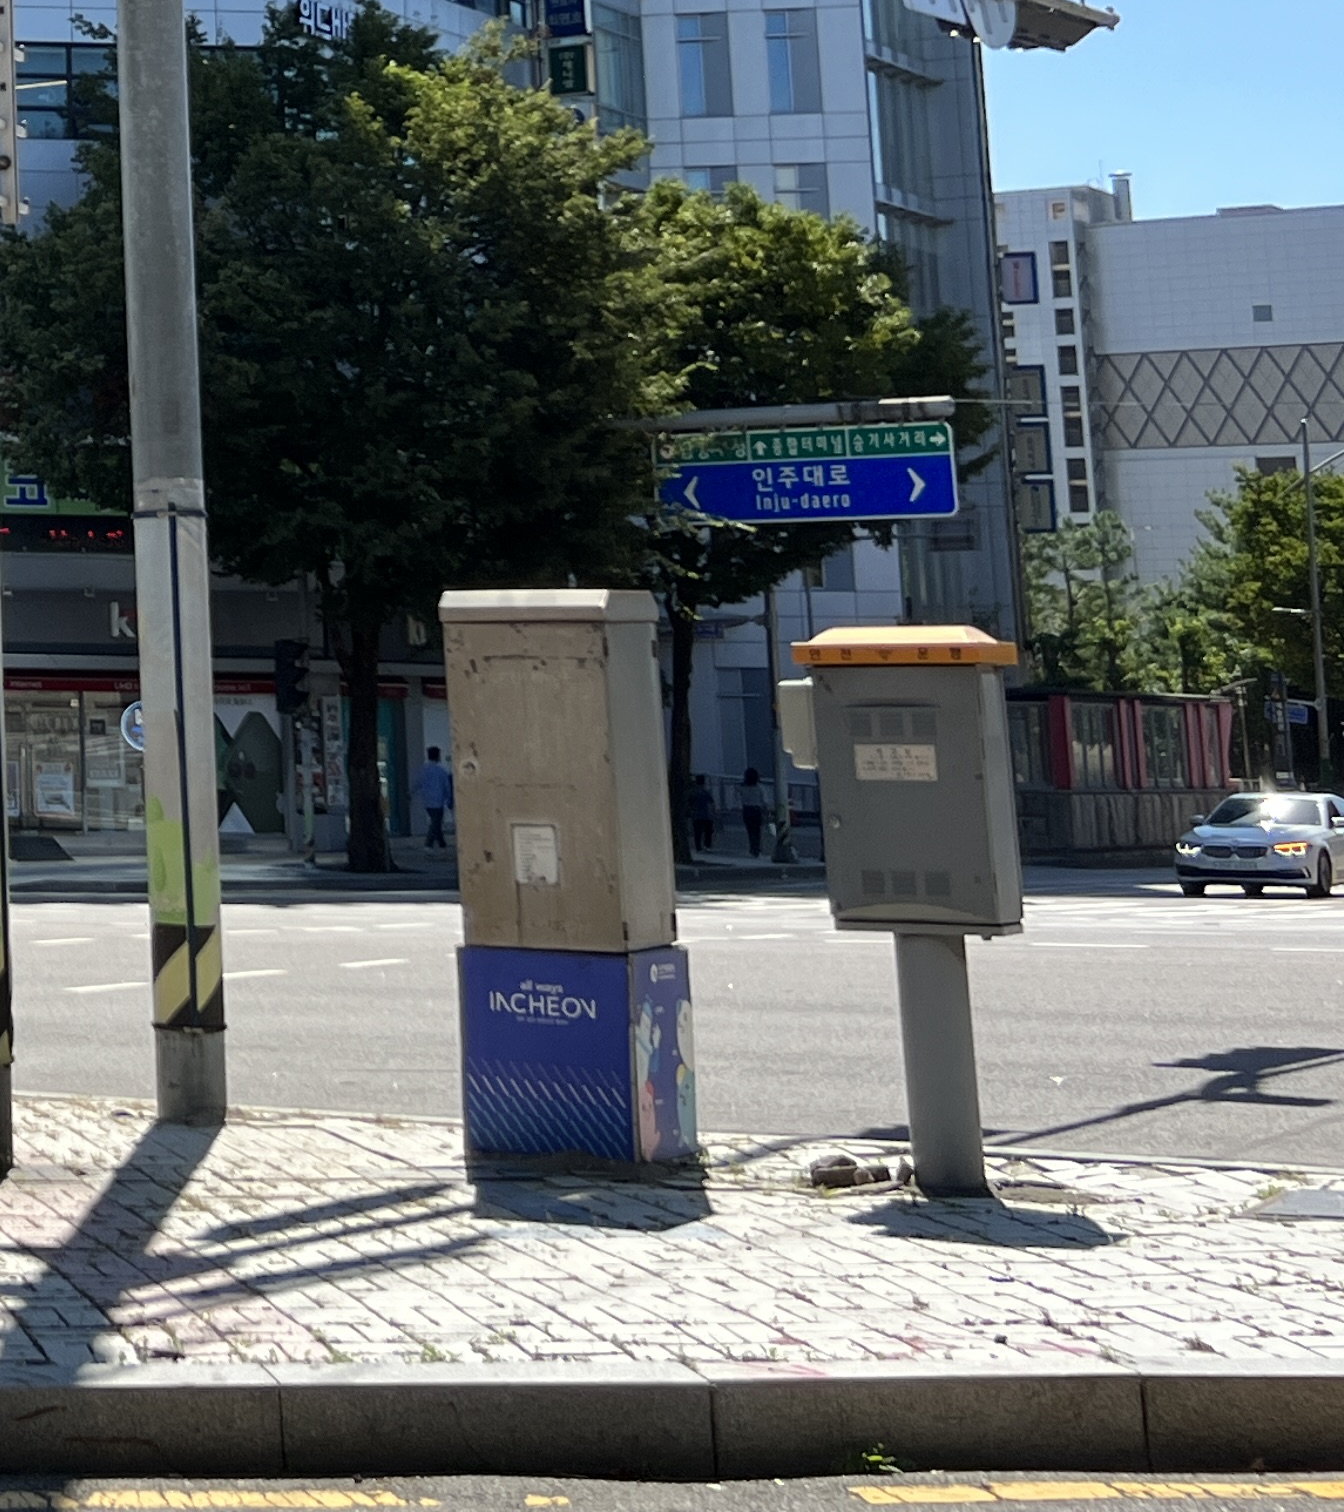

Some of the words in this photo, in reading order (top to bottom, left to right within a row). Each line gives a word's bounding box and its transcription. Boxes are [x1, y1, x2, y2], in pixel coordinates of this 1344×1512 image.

[772, 434, 843, 456] 종합터미널
[752, 464, 850, 492] 인주대로
[756, 492, 850, 512] Inju-daero
[111, 601, 136, 637] k
[489, 991, 596, 1020] INCHEON
